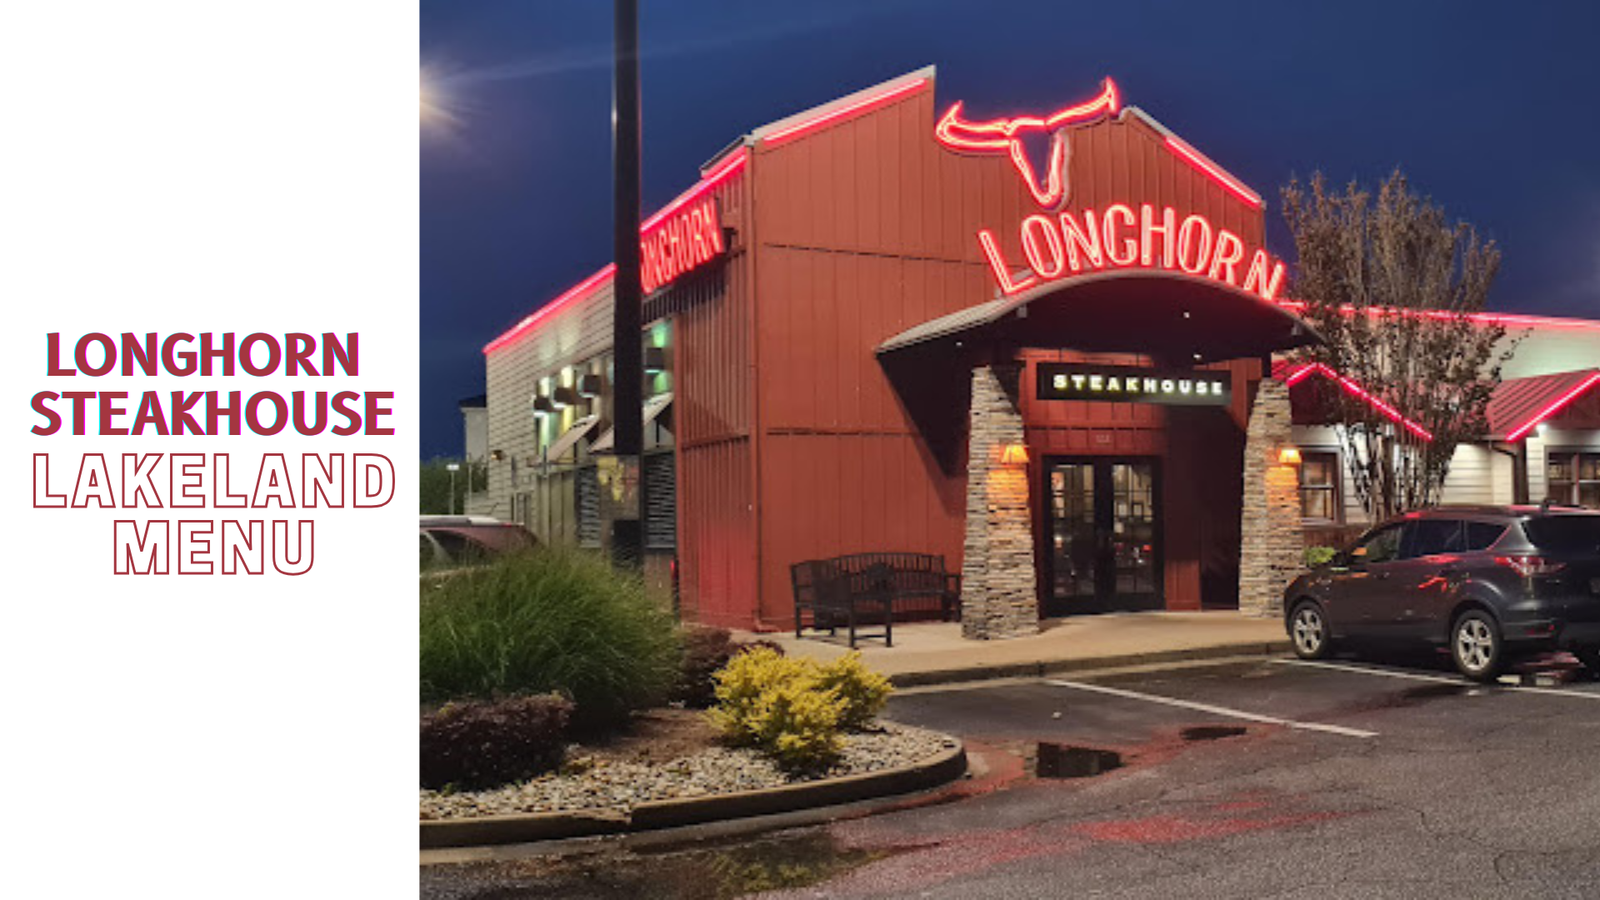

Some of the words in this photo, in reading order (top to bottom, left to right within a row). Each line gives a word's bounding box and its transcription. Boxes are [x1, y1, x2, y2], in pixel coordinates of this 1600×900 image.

[640, 196, 724, 295] ONGHORN
[978, 204, 1286, 301] LONGHORN
[1053, 374, 1223, 395] STEAKHOUSE
